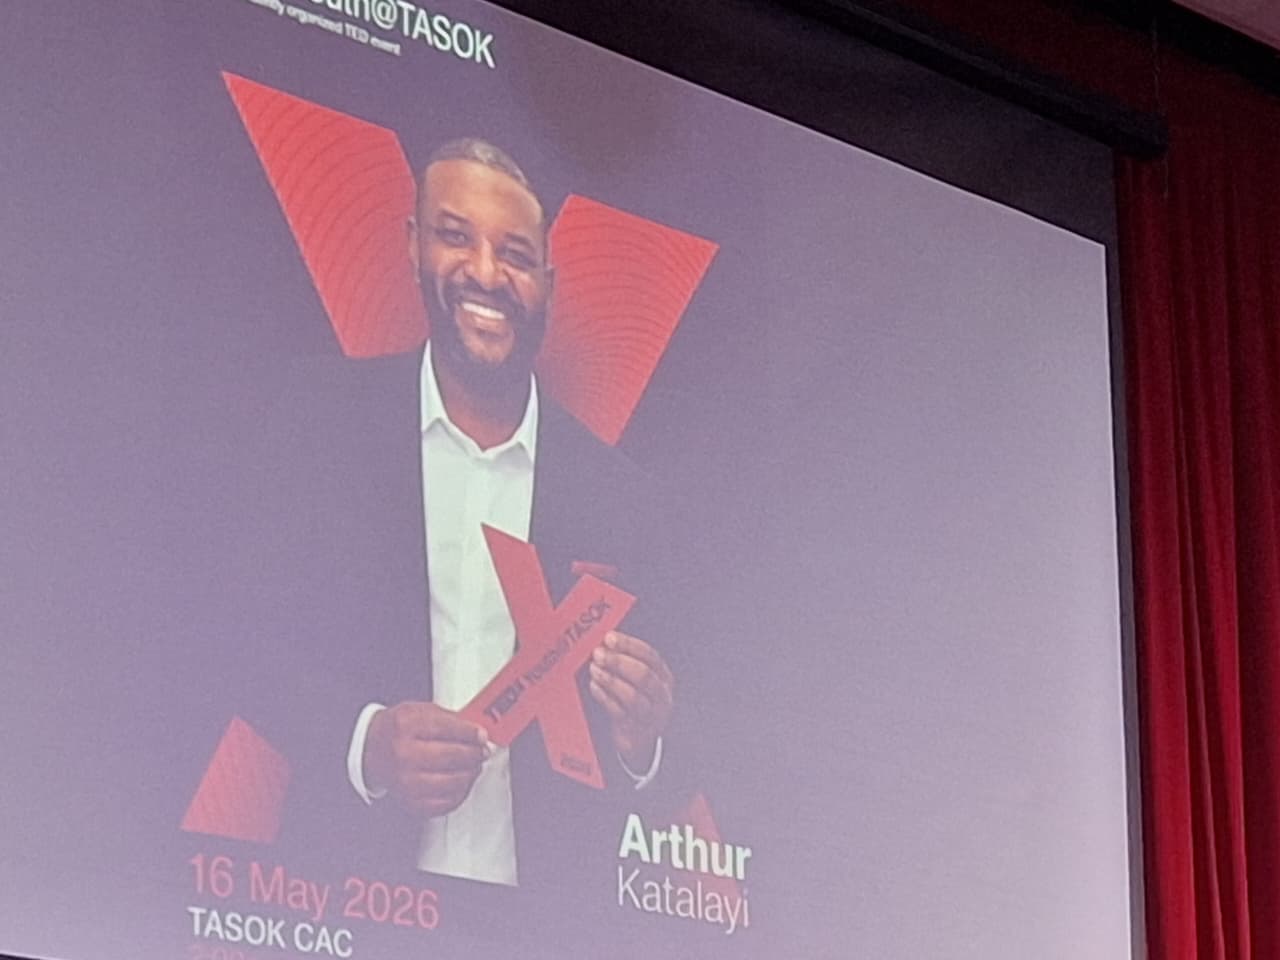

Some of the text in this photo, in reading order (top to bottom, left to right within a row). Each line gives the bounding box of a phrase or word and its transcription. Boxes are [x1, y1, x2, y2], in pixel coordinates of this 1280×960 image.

[310, 0, 496, 69] uth@TASOK
[345, 23, 370, 44] TED
[618, 813, 752, 880] Arthur
[188, 853, 439, 930] 16 May 2026
[618, 865, 749, 935] Katalayi
[187, 906, 354, 959] TASOK CAC
